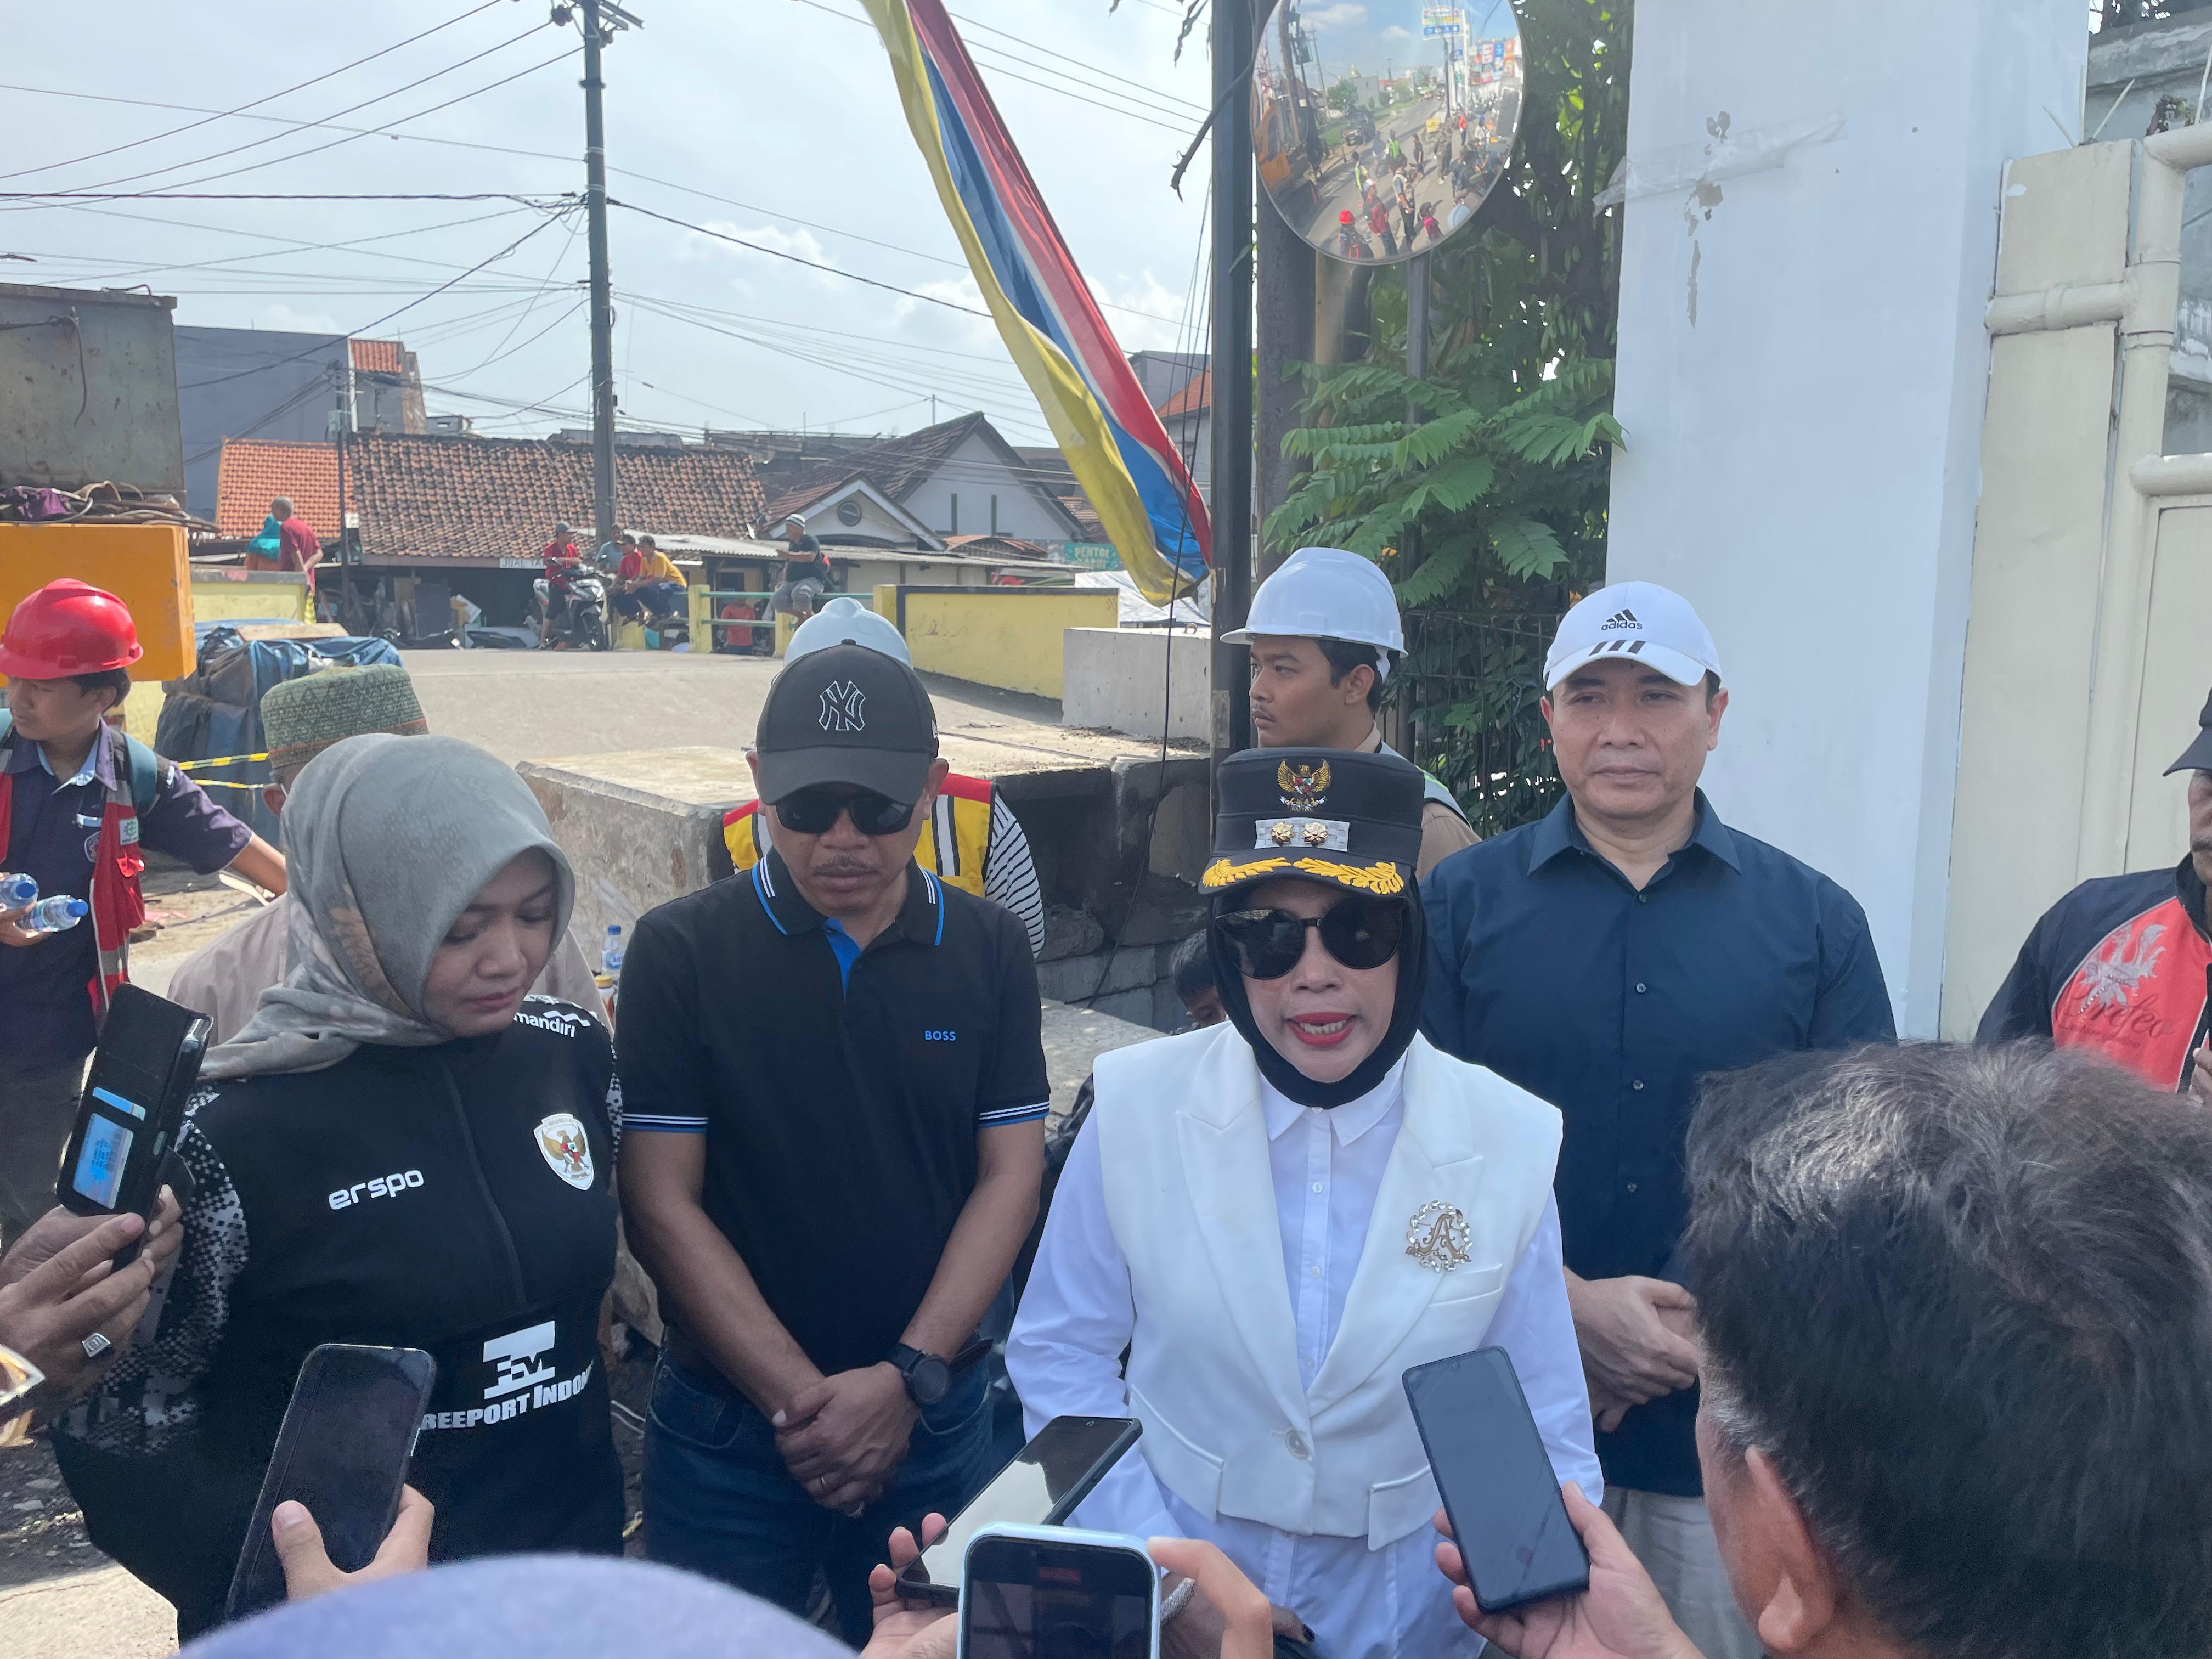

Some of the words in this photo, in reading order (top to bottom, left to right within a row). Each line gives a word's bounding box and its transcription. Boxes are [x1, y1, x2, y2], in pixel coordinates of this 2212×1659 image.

[501, 558, 525, 568] JUAL
[1601, 620, 1643, 631] adidas
[514, 1012, 575, 1038] mandiri
[924, 1030, 956, 1041] BOSS
[328, 1169, 424, 1210] erspo
[421, 1393, 531, 1430] REEPORT
